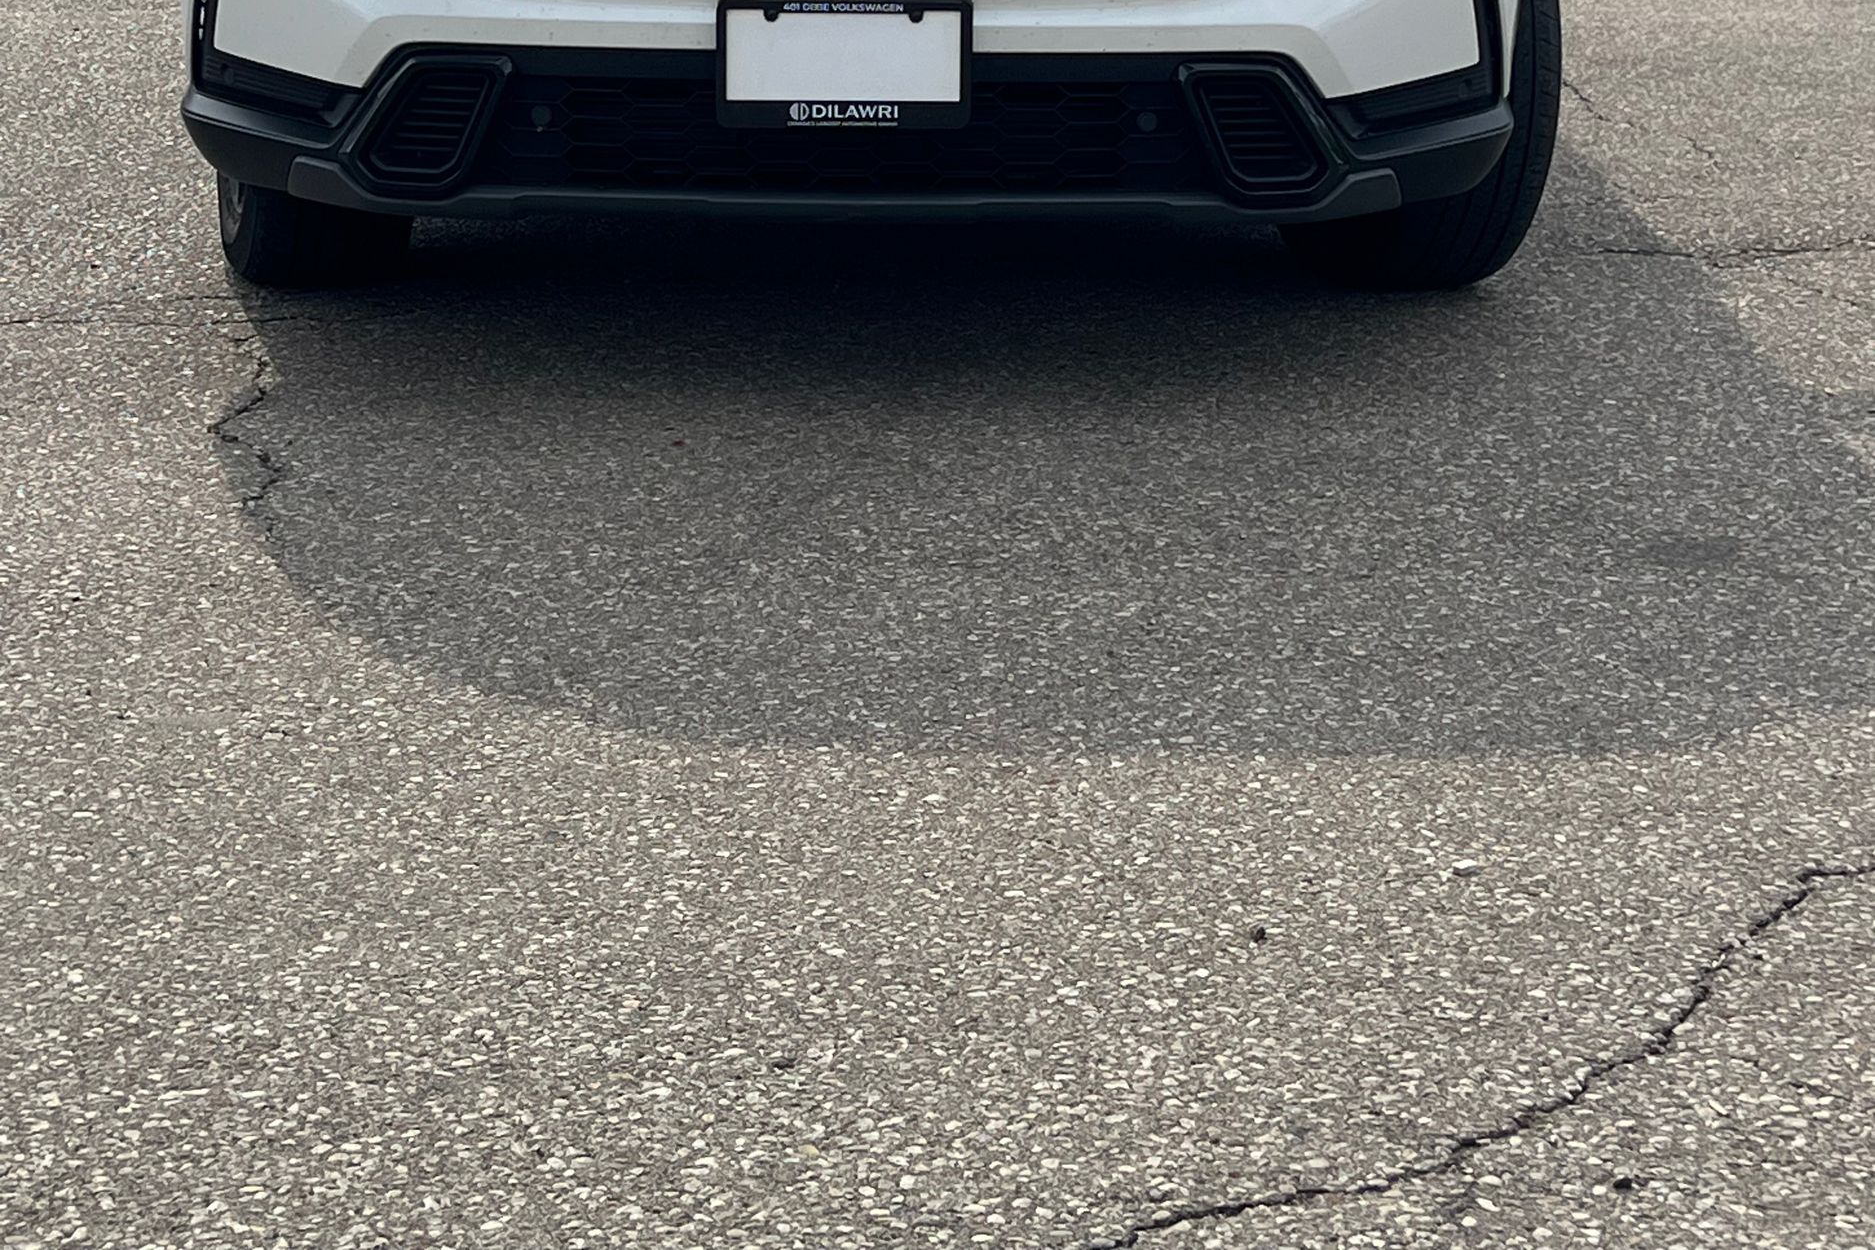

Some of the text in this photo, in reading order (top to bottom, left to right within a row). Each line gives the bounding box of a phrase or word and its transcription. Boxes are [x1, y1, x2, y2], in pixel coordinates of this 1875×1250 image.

[783, 2, 801, 12] 401
[831, 2, 905, 12] VOLKSWAGEN
[811, 104, 898, 119] DILAWRI
